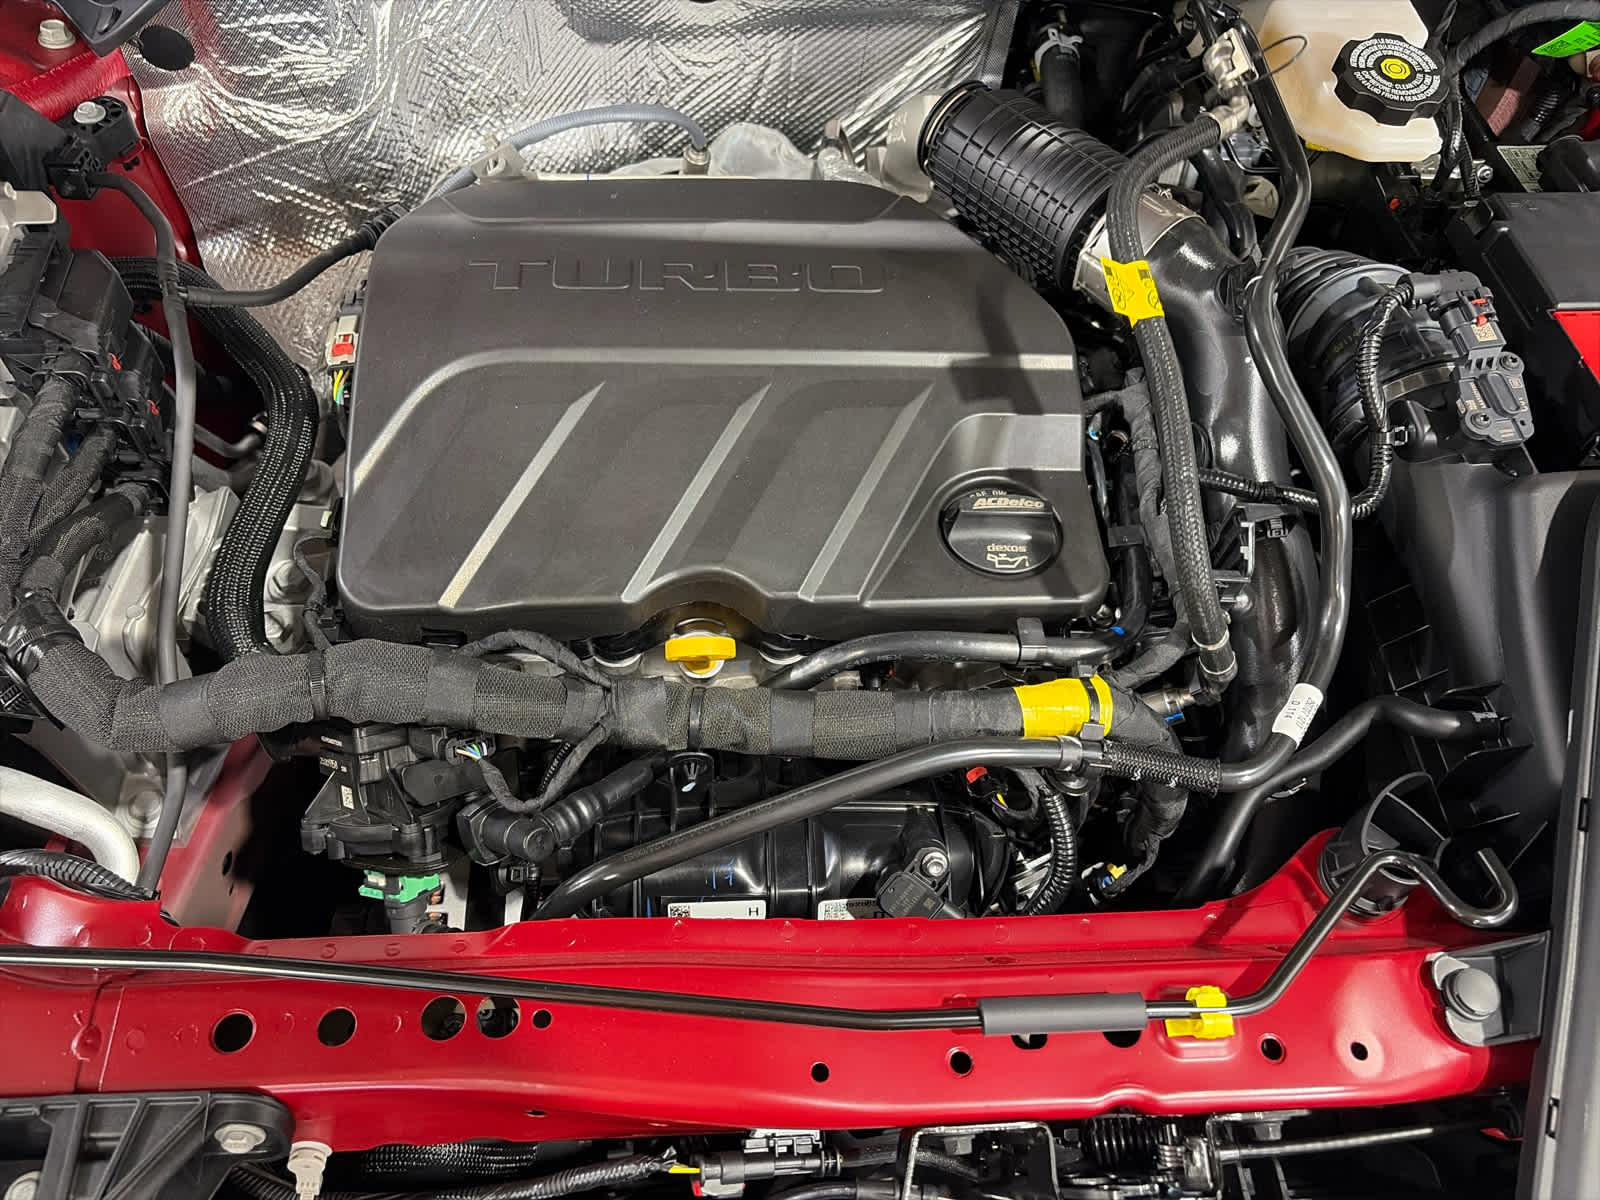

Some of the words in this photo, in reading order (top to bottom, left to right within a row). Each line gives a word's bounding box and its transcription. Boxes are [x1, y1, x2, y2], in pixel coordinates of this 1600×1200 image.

[1365, 82, 1382, 95] FLUID
[1381, 91, 1399, 101] FROM
[1369, 79, 1391, 92] BEFORE
[467, 258, 885, 293] TURBO
[973, 497, 1045, 509] ACDelco
[986, 543, 1027, 553] dexos
[748, 902, 759, 912] H
